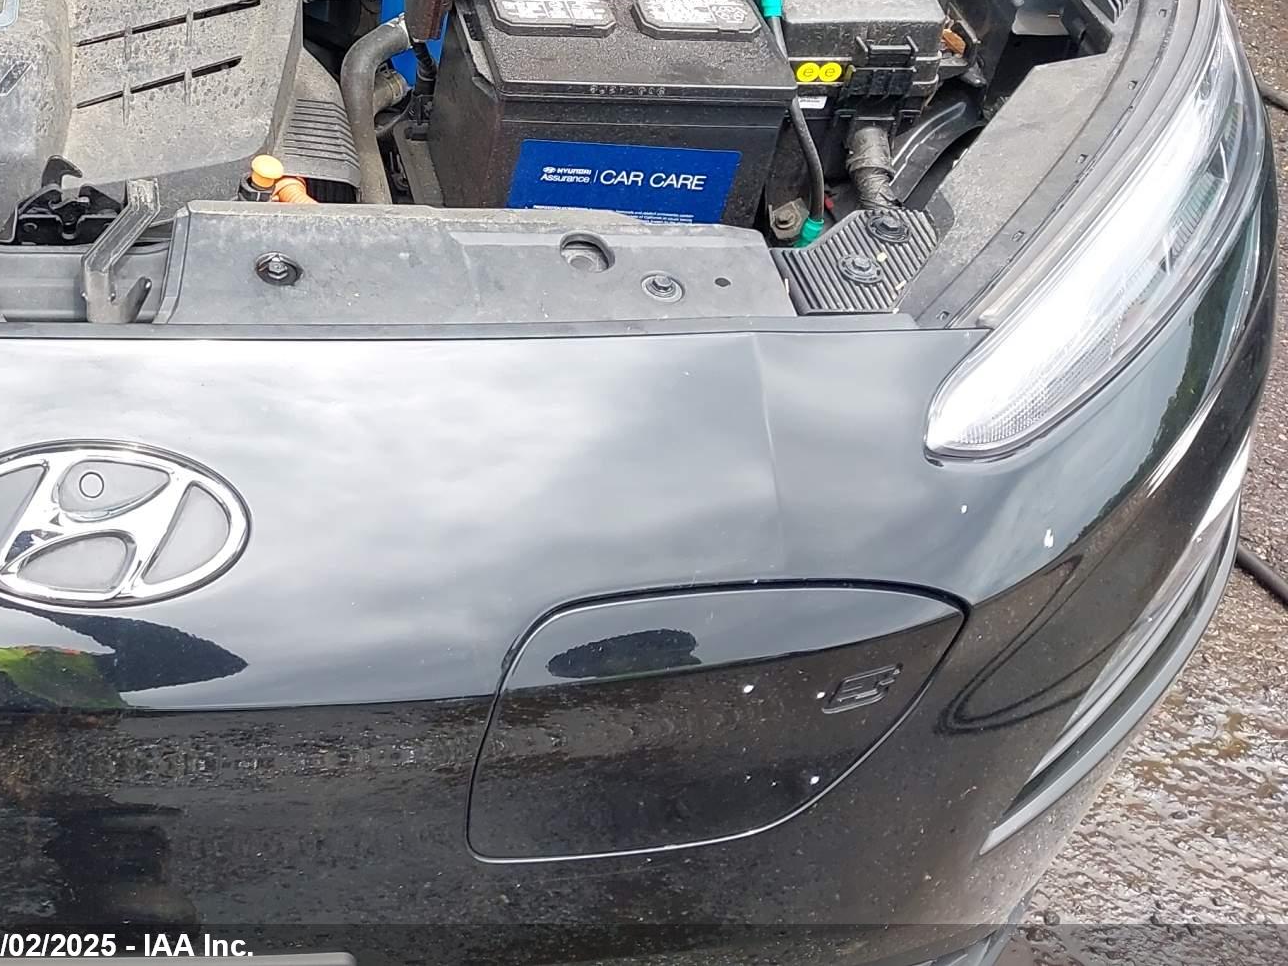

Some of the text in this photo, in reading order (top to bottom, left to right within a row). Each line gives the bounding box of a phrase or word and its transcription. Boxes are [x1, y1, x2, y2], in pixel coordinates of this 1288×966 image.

[540, 170, 707, 190] Assurance CAR CARE
